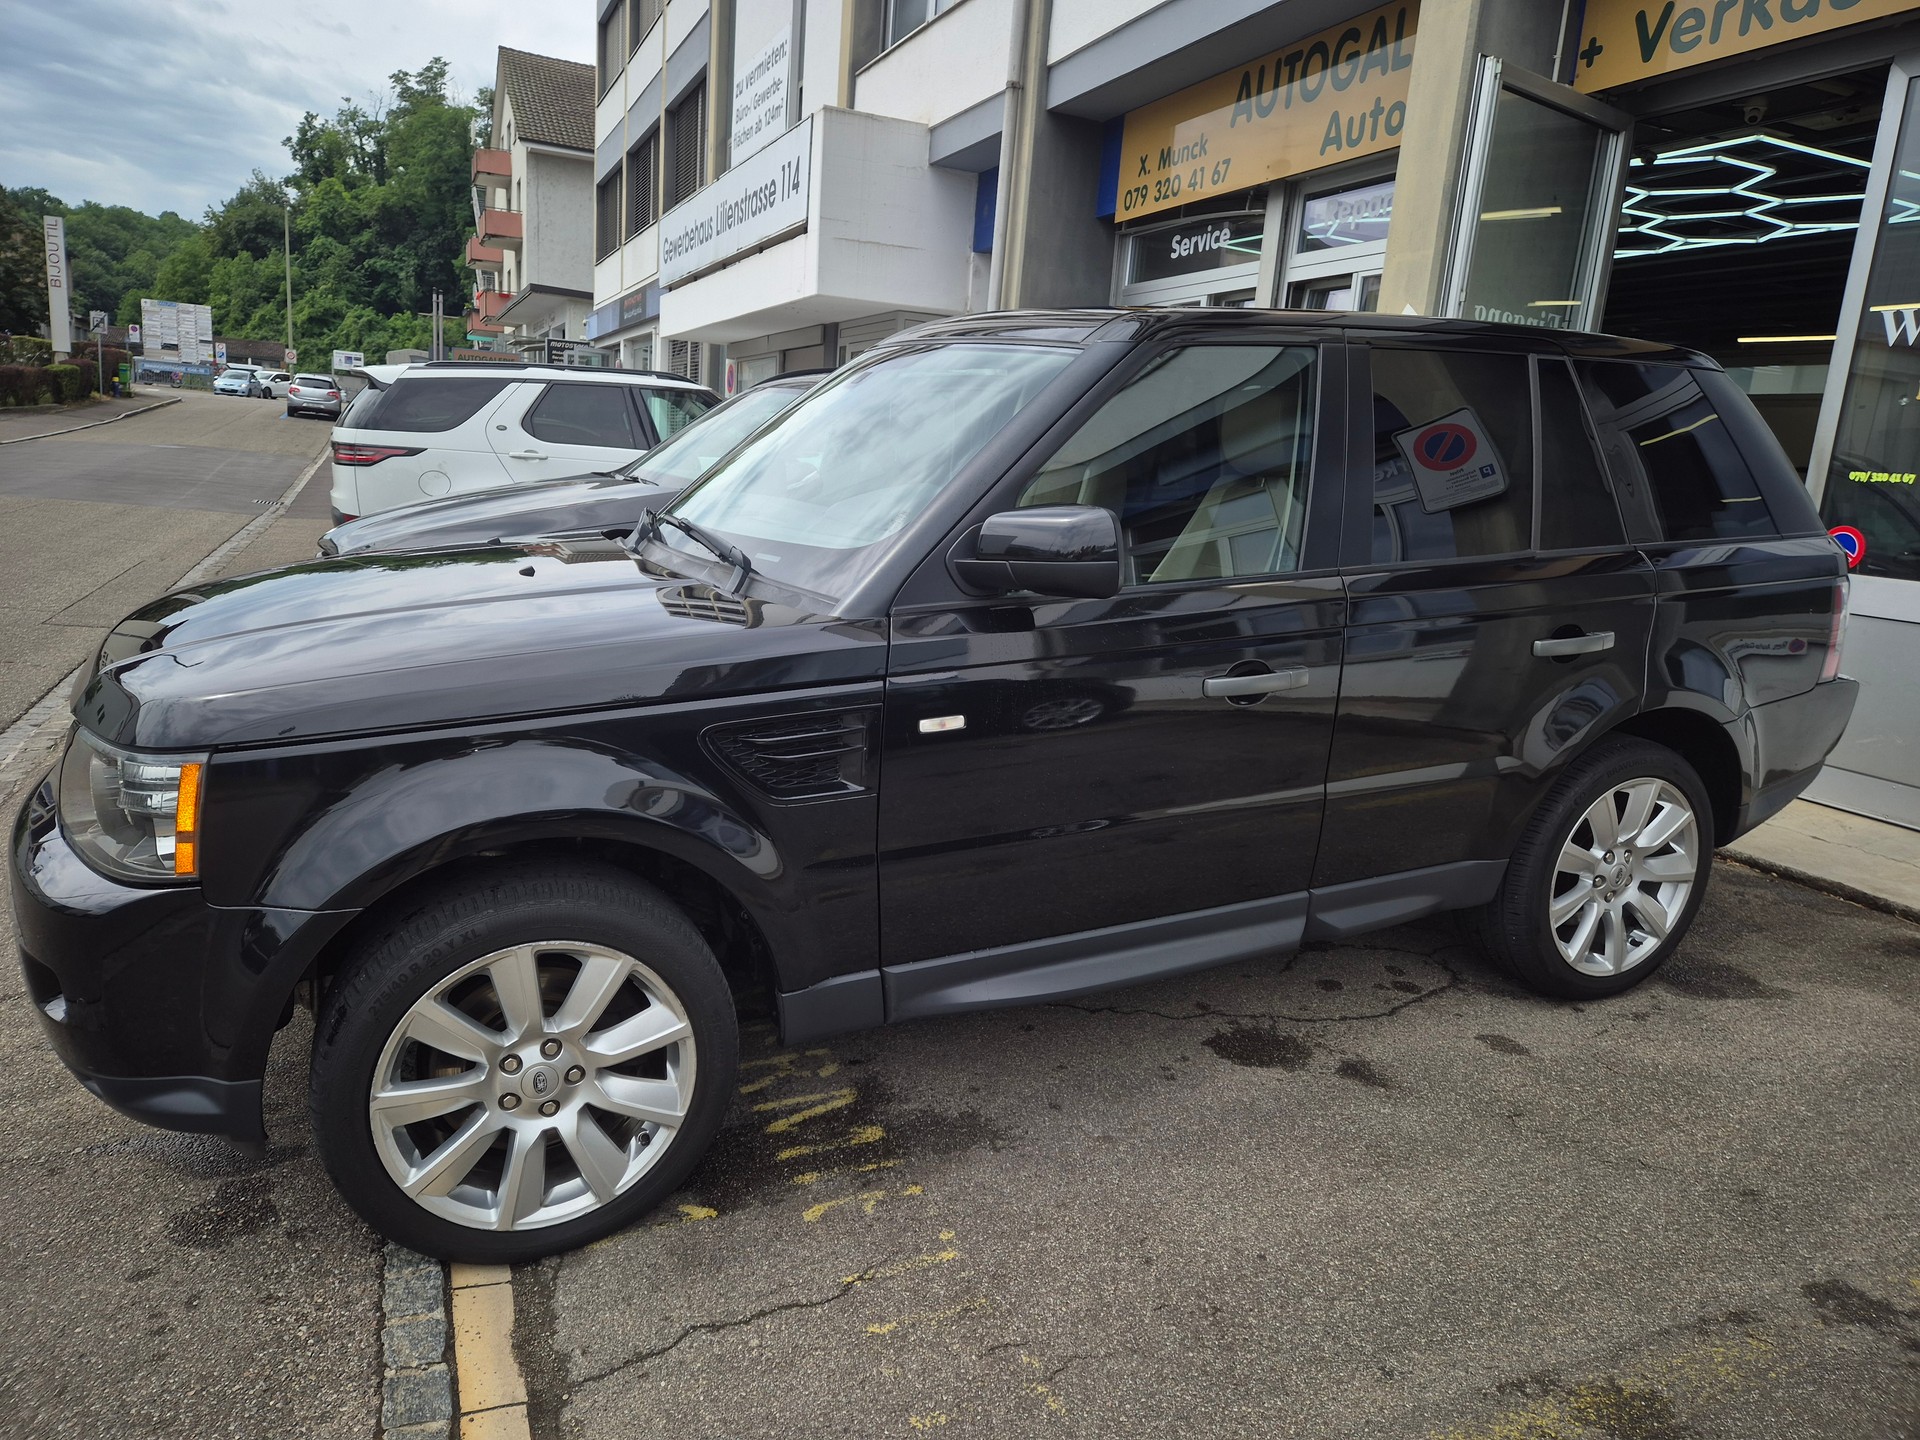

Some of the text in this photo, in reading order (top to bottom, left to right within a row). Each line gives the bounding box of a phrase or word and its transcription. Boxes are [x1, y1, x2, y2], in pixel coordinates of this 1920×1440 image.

[1634, 0, 1862, 64] Verk
[745, 38, 788, 90] vermieten:
[1230, 6, 1413, 129] AUTOGAL
[753, 76, 783, 111] Gewerbe-
[755, 114, 762, 135] ab
[1319, 96, 1407, 157] Auto
[1138, 132, 1208, 178] X. Munck
[663, 155, 800, 264] Gewerbehaus Lilienstrasse 114
[1123, 157, 1232, 212] 079 320 41 67
[46, 218, 62, 288] BIJOUTIL
[1170, 224, 1231, 259] Service
